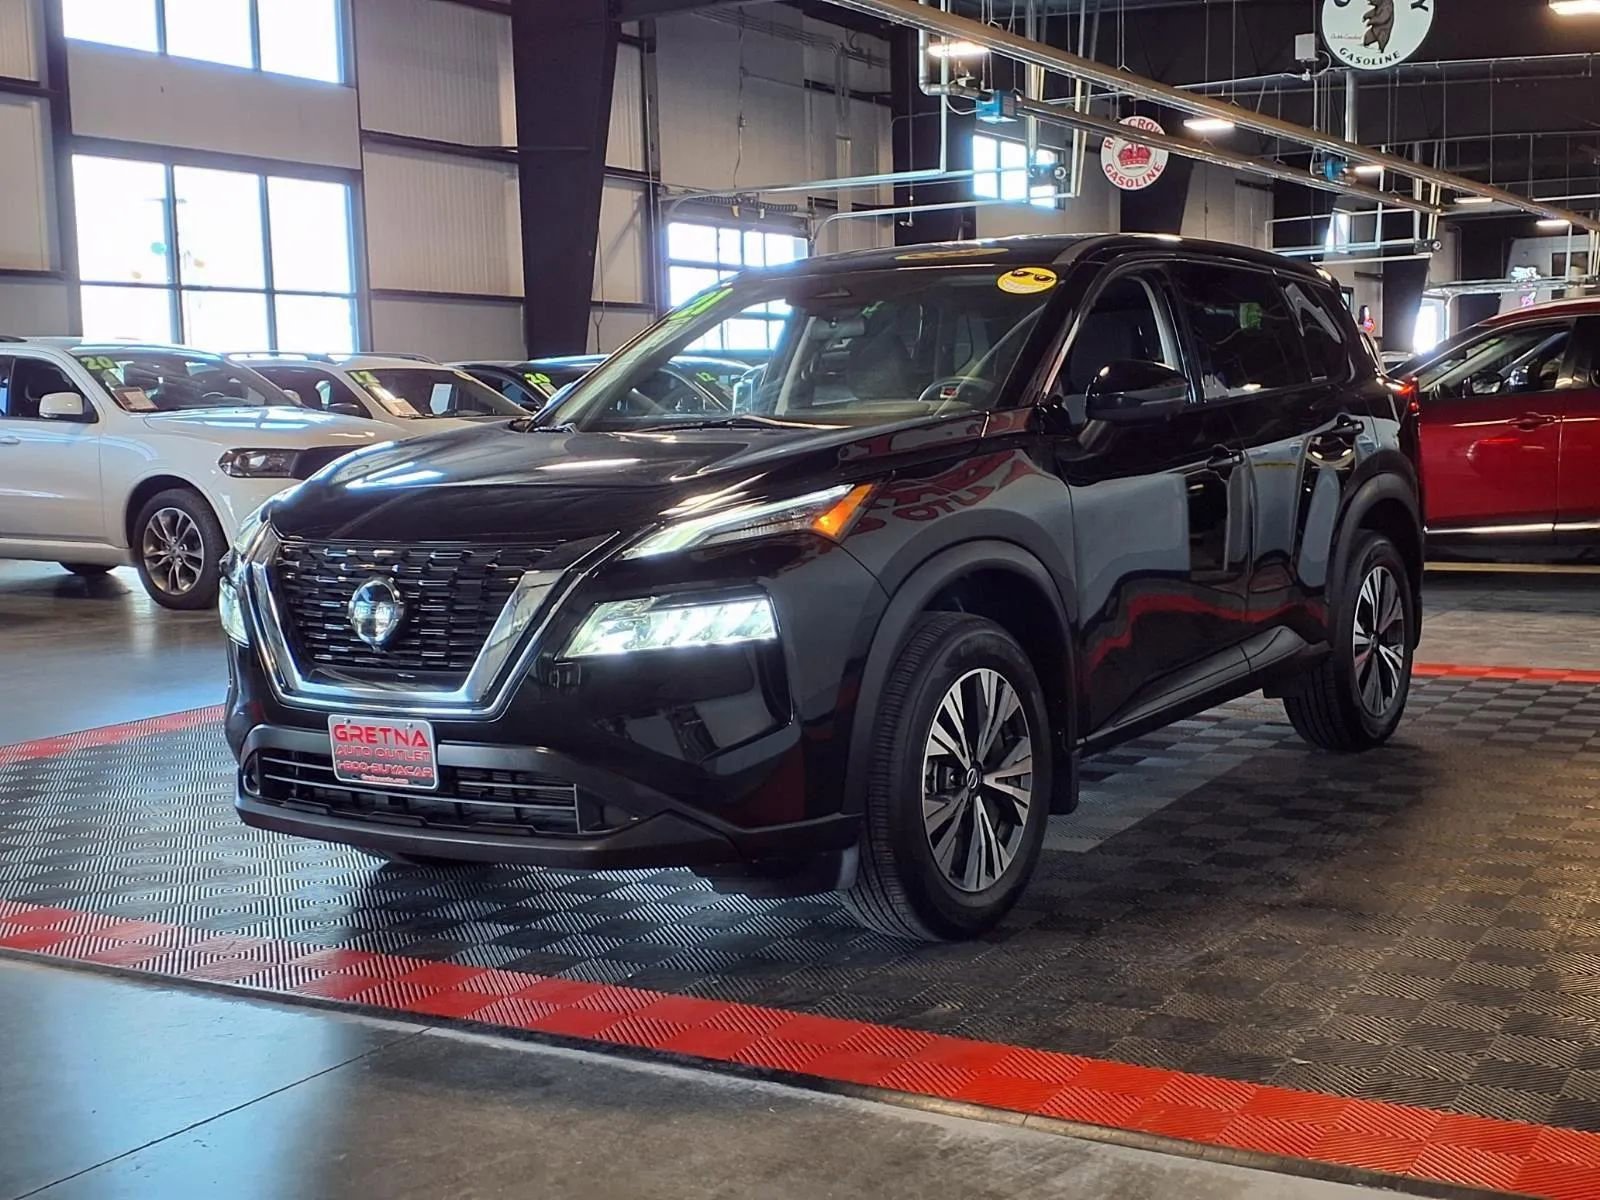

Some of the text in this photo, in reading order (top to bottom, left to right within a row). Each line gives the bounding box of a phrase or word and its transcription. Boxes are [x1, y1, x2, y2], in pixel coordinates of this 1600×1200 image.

[1339, 47, 1401, 65] GASOLINE
[1105, 162, 1163, 188] GASOLINE
[80, 355, 115, 370] 20
[334, 725, 428, 747] GRETNA
[335, 744, 431, 761] AUTO OUTLET
